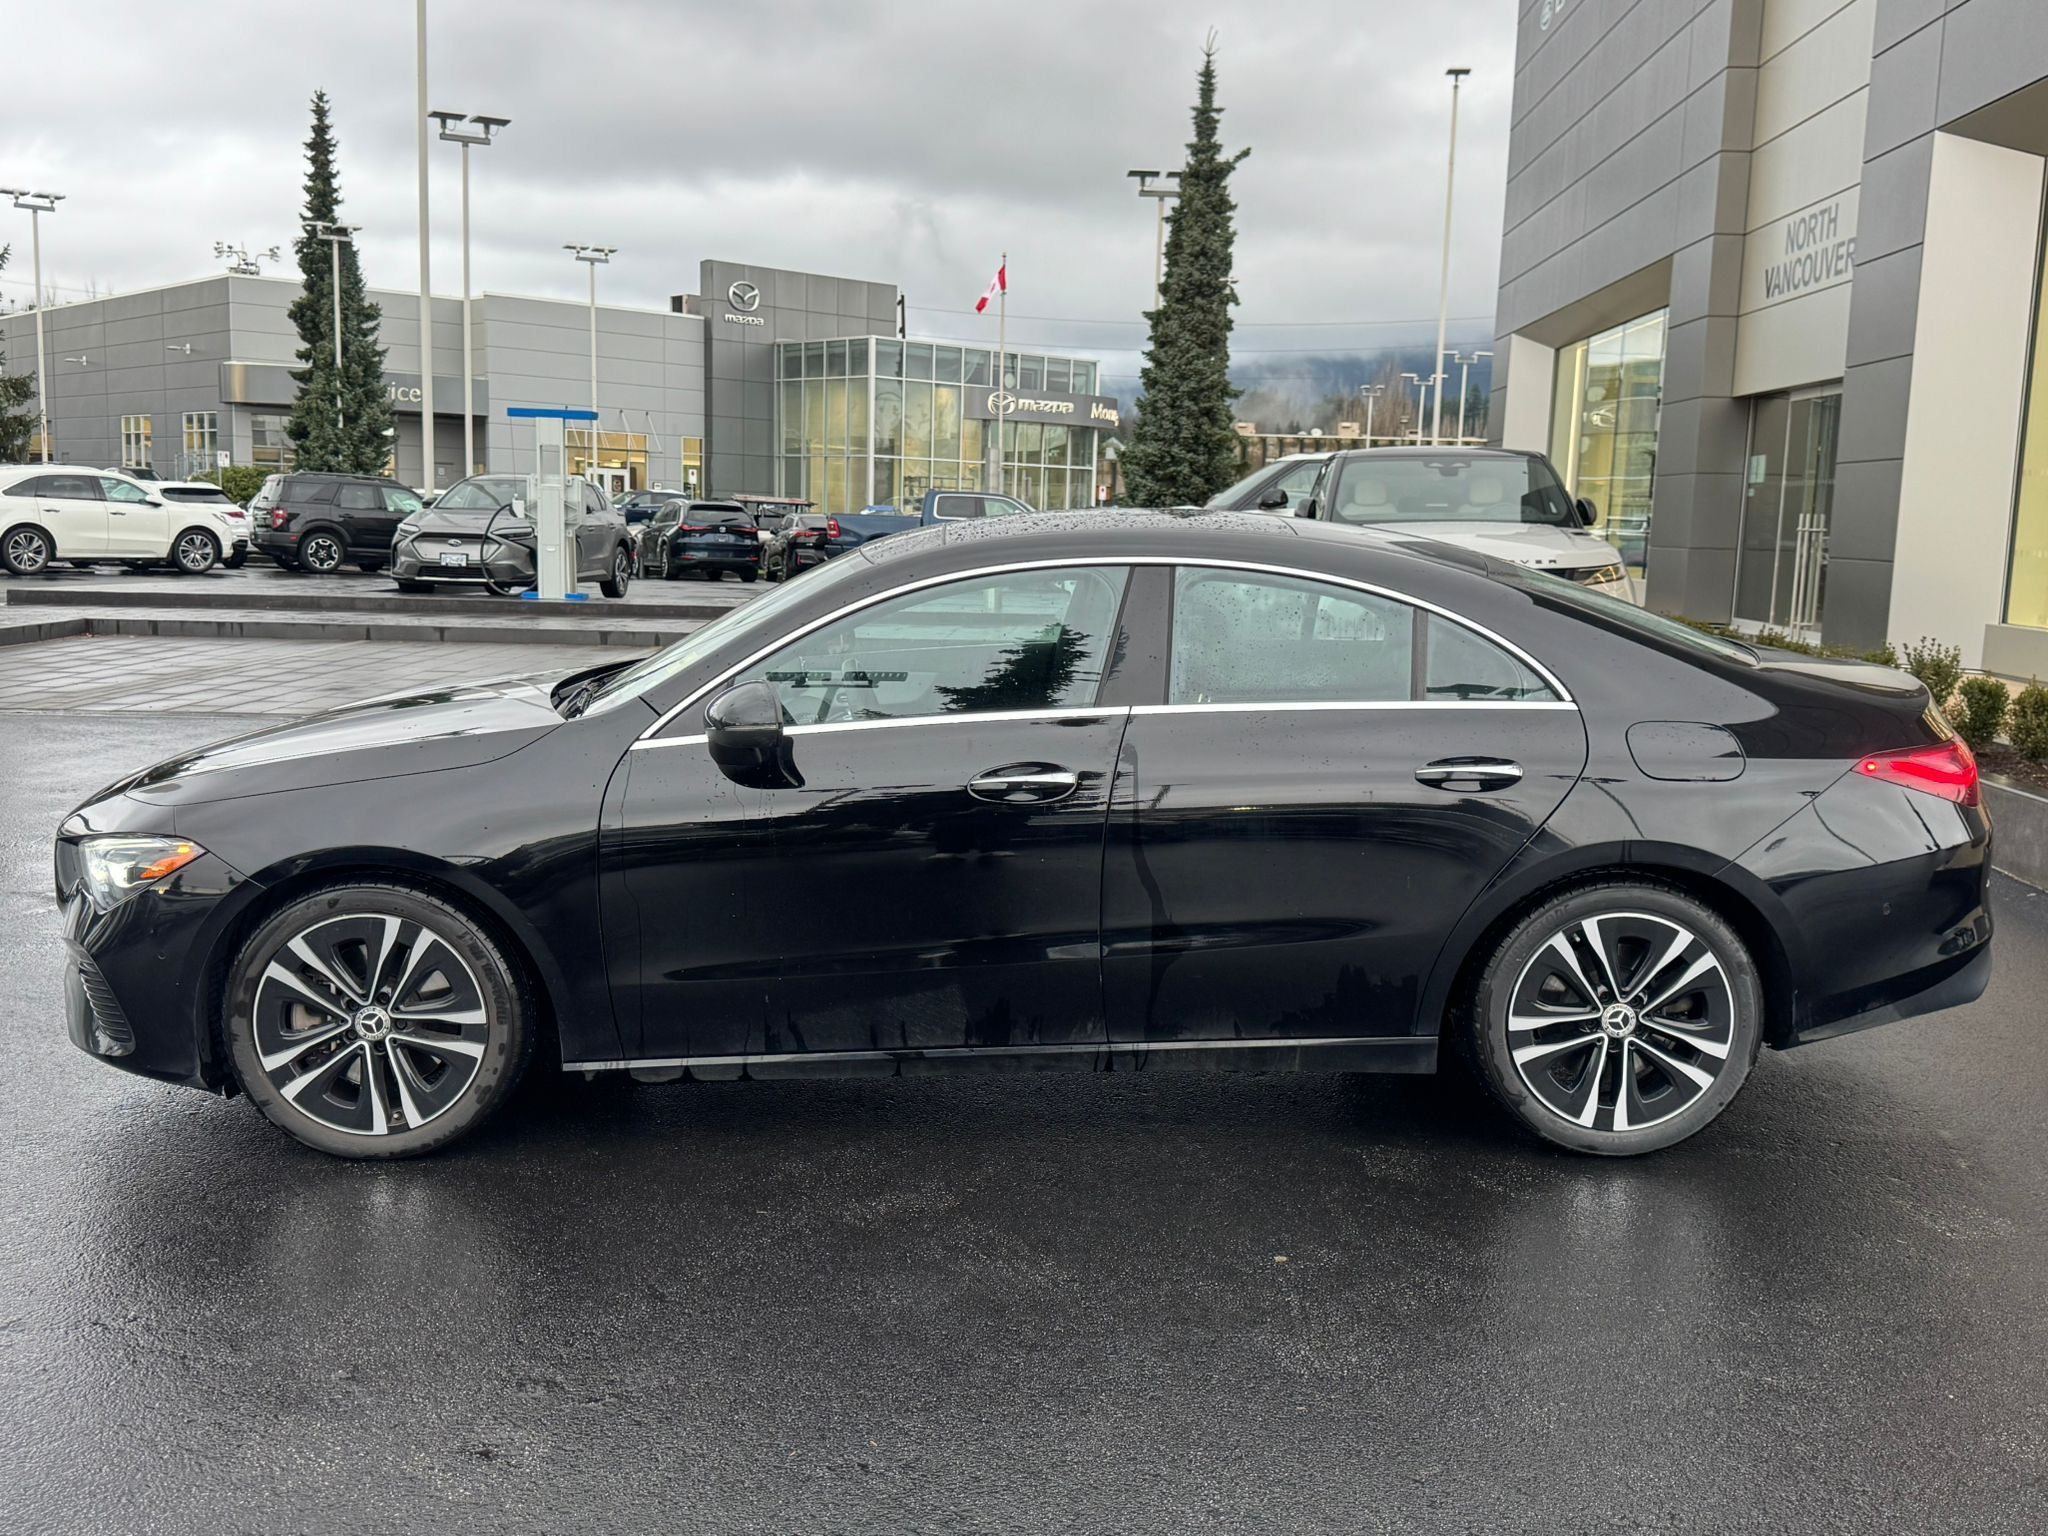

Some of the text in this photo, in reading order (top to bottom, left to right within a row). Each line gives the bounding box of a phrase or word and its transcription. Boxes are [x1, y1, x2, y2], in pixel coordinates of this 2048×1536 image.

[1785, 202, 1839, 255] NORTH
[1765, 236, 1857, 299] VANCOUVER
[724, 313, 764, 326] mazda
[388, 381, 422, 402] ice
[1018, 398, 1075, 414] mazda
